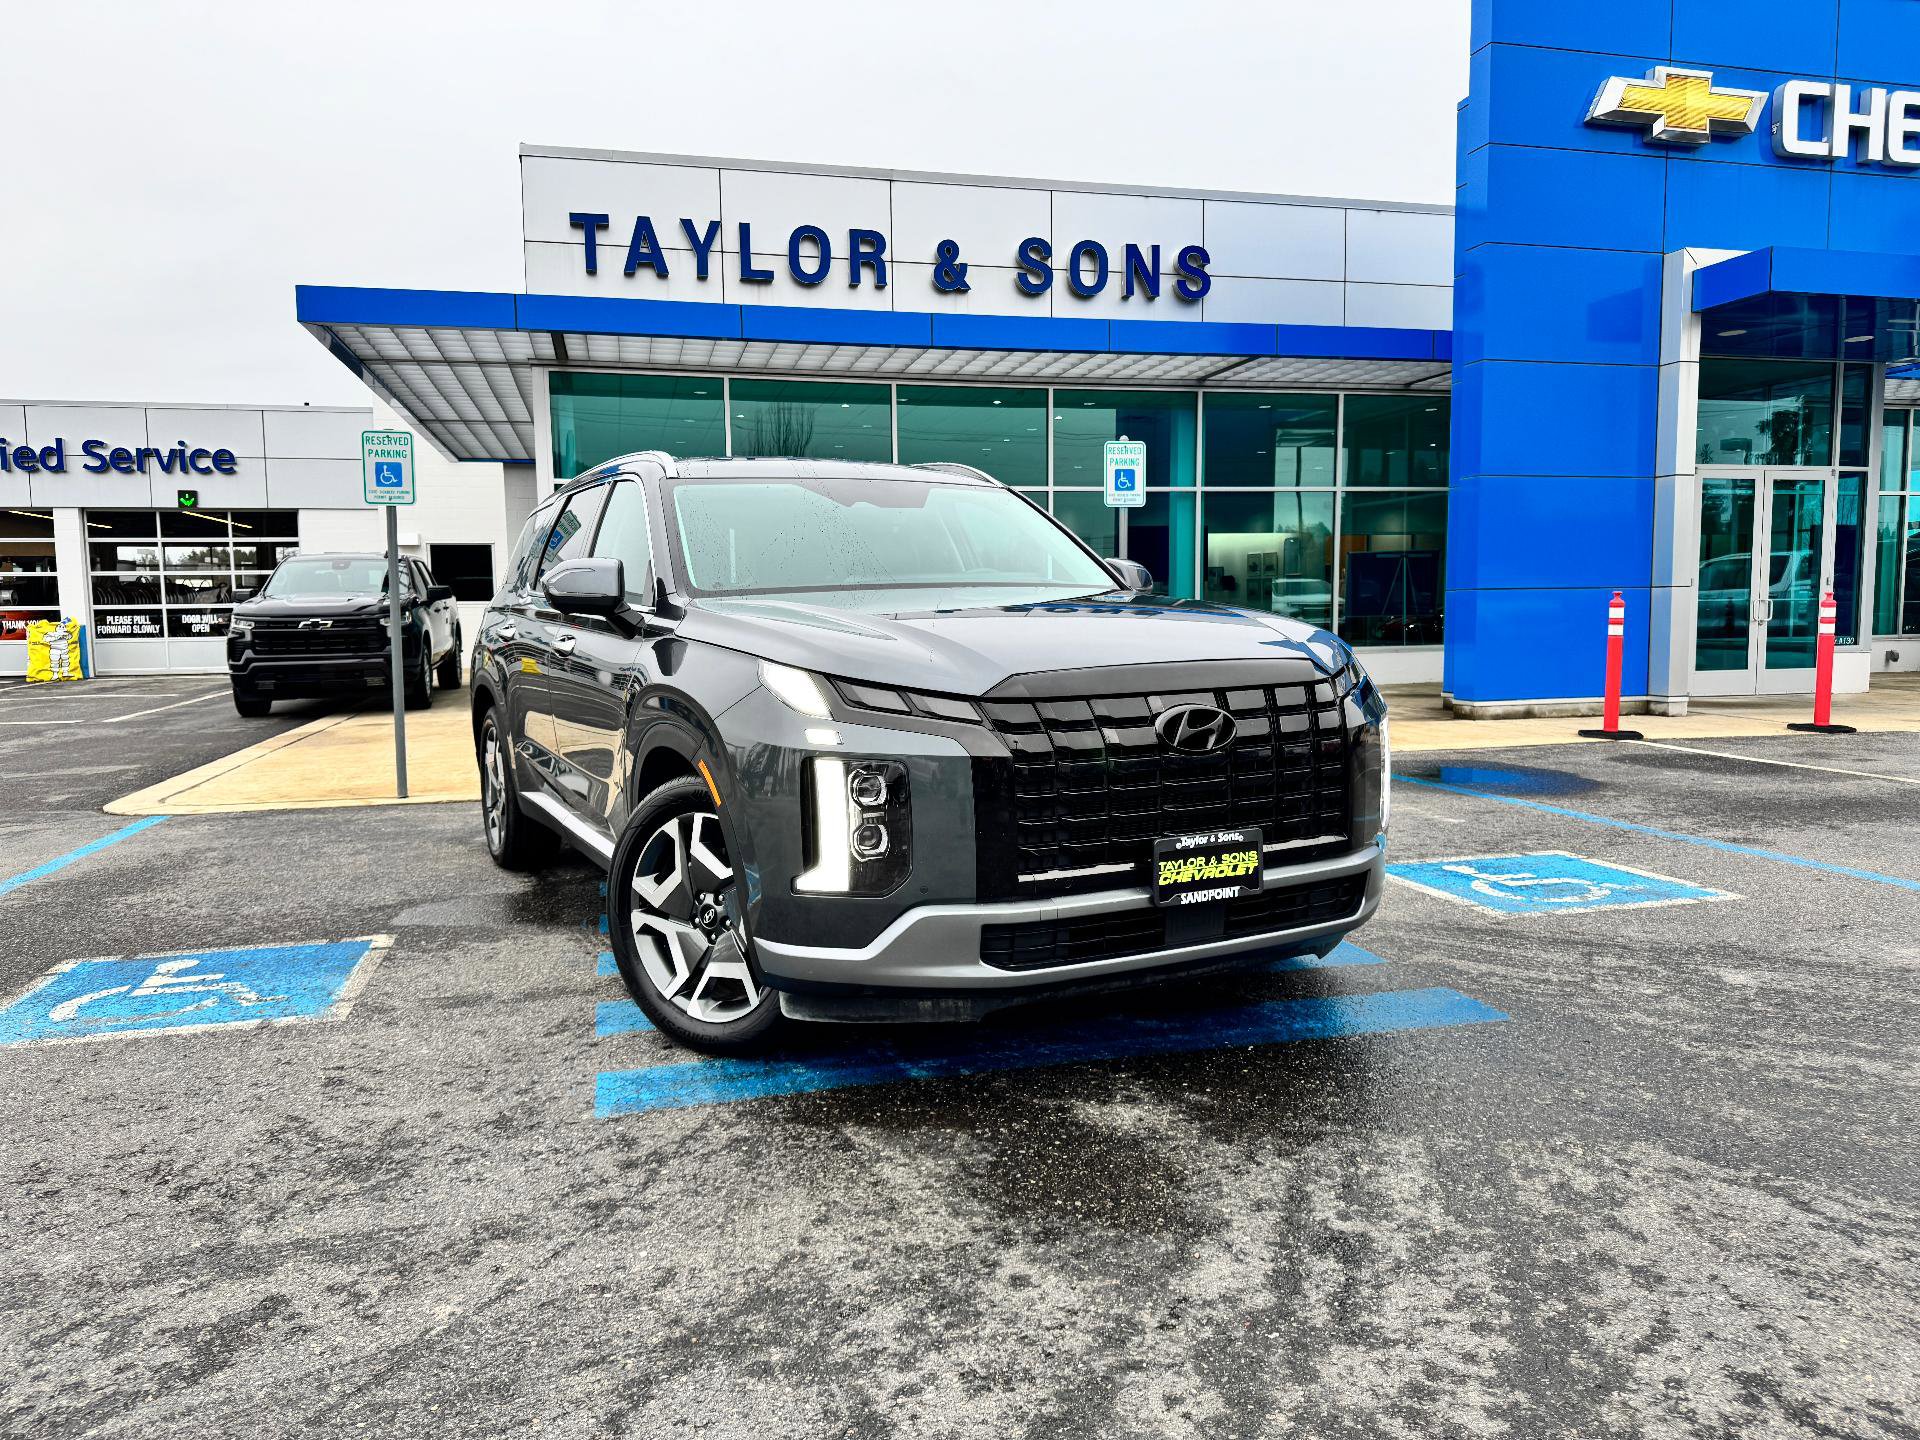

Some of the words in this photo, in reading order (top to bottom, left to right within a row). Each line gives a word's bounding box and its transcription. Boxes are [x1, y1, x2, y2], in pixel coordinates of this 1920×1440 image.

[1773, 80, 1920, 164] CHE
[569, 212, 887, 288] TAYLOR
[932, 239, 971, 292] &
[1015, 237, 1212, 301] SONS
[365, 435, 409, 446] RESERVED
[368, 449, 407, 459] PARKING
[1108, 446, 1142, 455] RESERVED
[81, 439, 238, 474] Service
[1110, 458, 1140, 467] PARKING
[106, 615, 132, 625] PLEASE
[133, 615, 152, 625] PULL
[181, 614, 202, 624] DOOR
[202, 614, 219, 624] WILL
[2, 620, 26, 630] THANK
[97, 624, 132, 634] FORWARD
[133, 624, 161, 634] SLOWLY
[191, 623, 211, 633] OPEN
[1181, 836, 1209, 848] Taylor
[1218, 833, 1239, 842] Sons
[1159, 857, 1205, 871] TAYLOR
[1209, 856, 1218, 867] &
[1222, 850, 1258, 864] SONS
[1158, 862, 1259, 886] CHEVROLET
[1180, 886, 1241, 904] SANDPOINT
